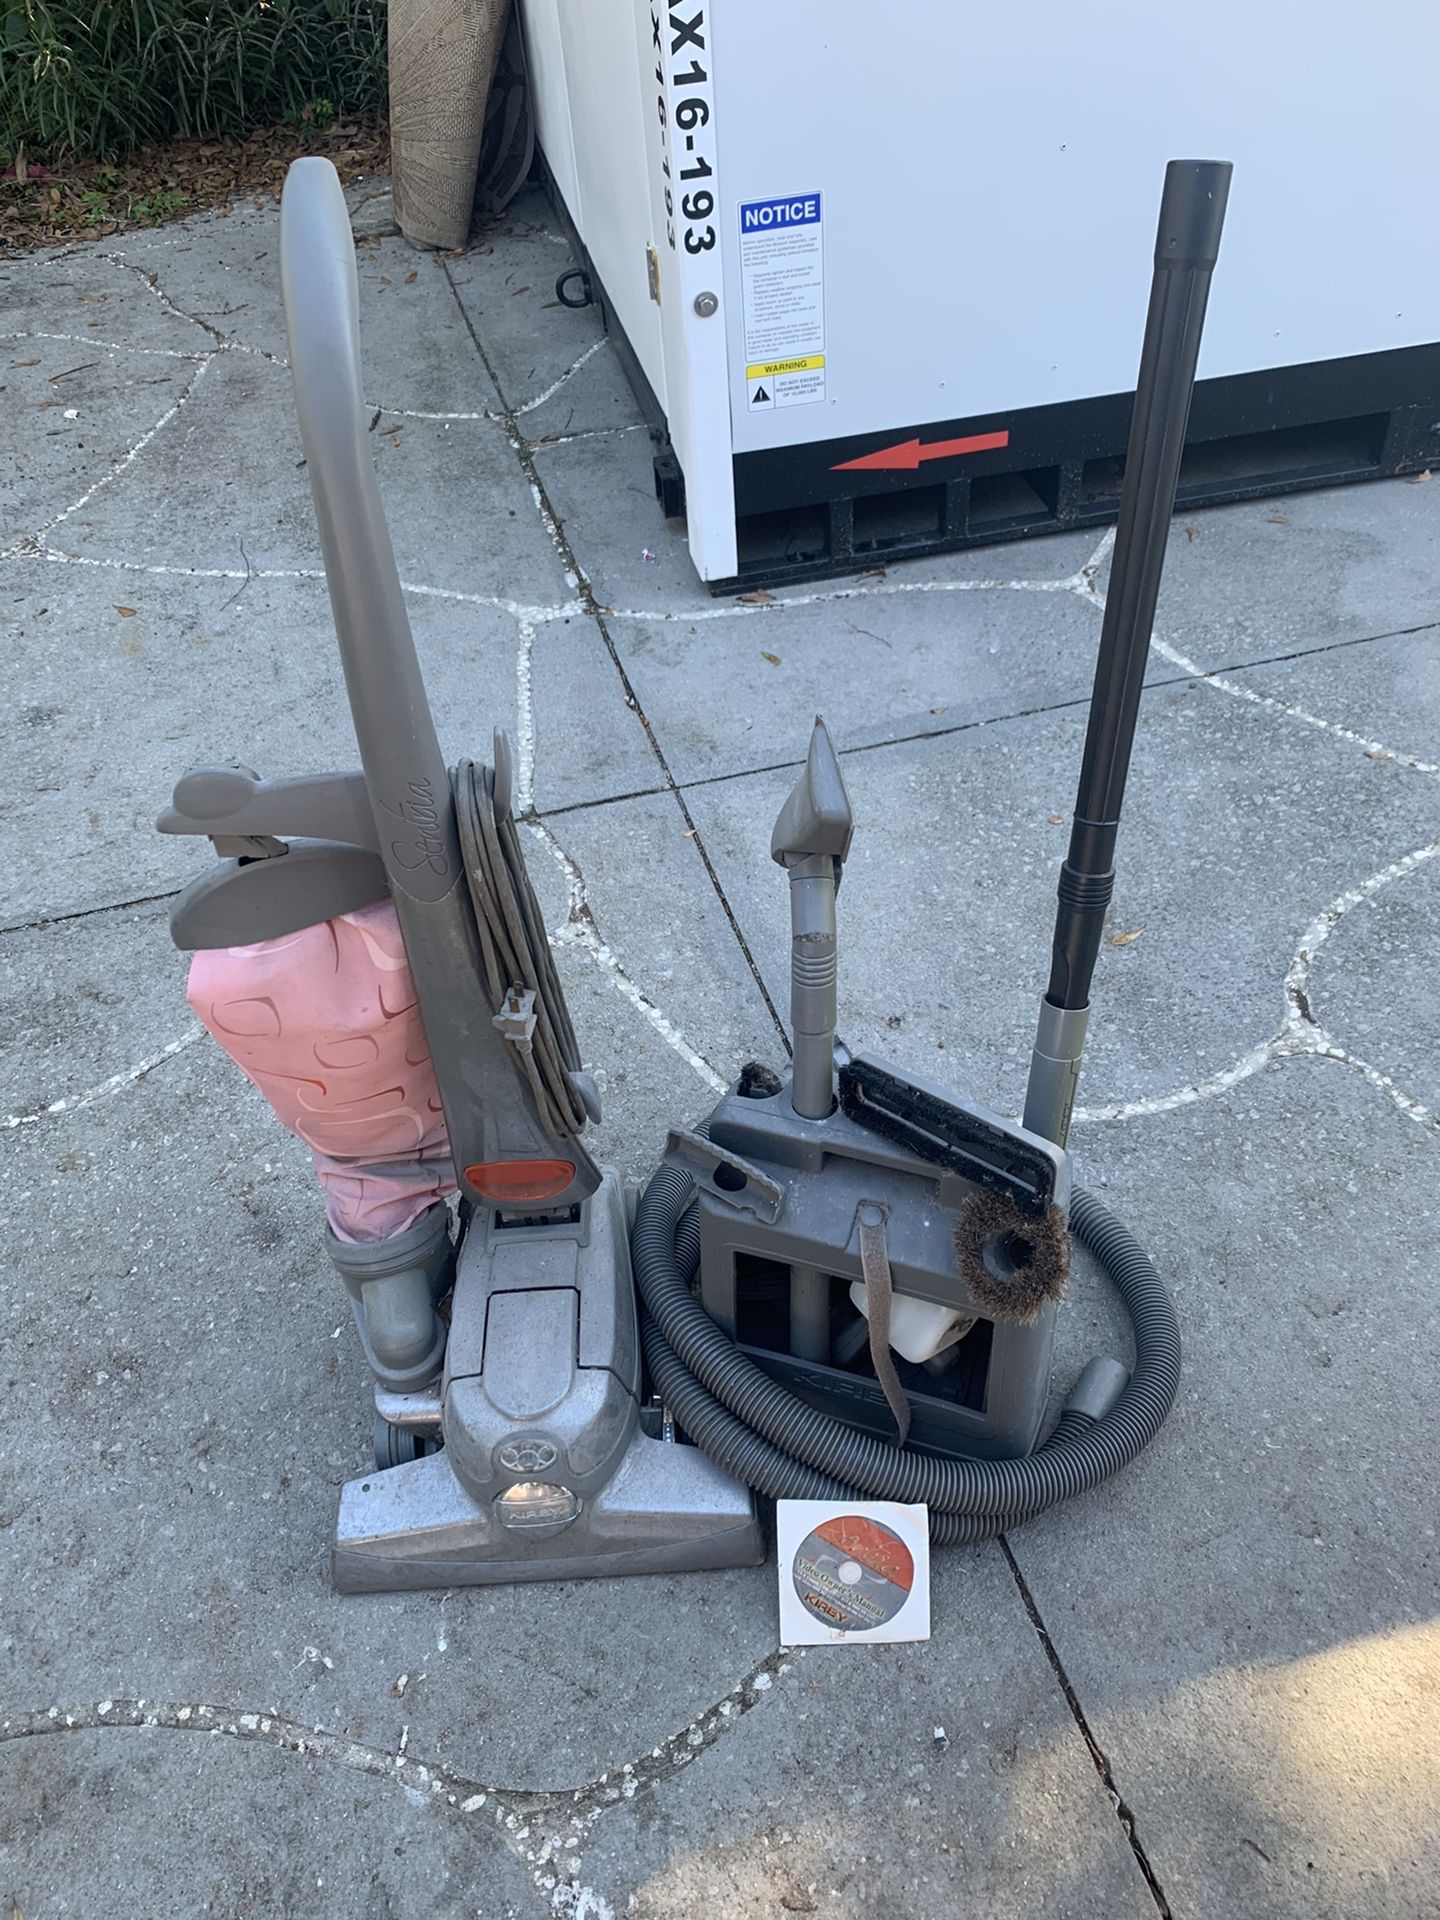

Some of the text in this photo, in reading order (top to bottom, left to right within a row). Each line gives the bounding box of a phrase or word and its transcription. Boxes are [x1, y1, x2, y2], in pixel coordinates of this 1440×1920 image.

[649, 0, 675, 250] X16-193
[668, 0, 716, 255] X16-193
[745, 200, 817, 228] NOTICE
[764, 360, 807, 373] WARNING
[798, 1558, 820, 1579] Video
[820, 1572, 853, 1599] Owner's
[853, 1593, 886, 1618] Manual
[804, 1592, 849, 1622] KIRBY
